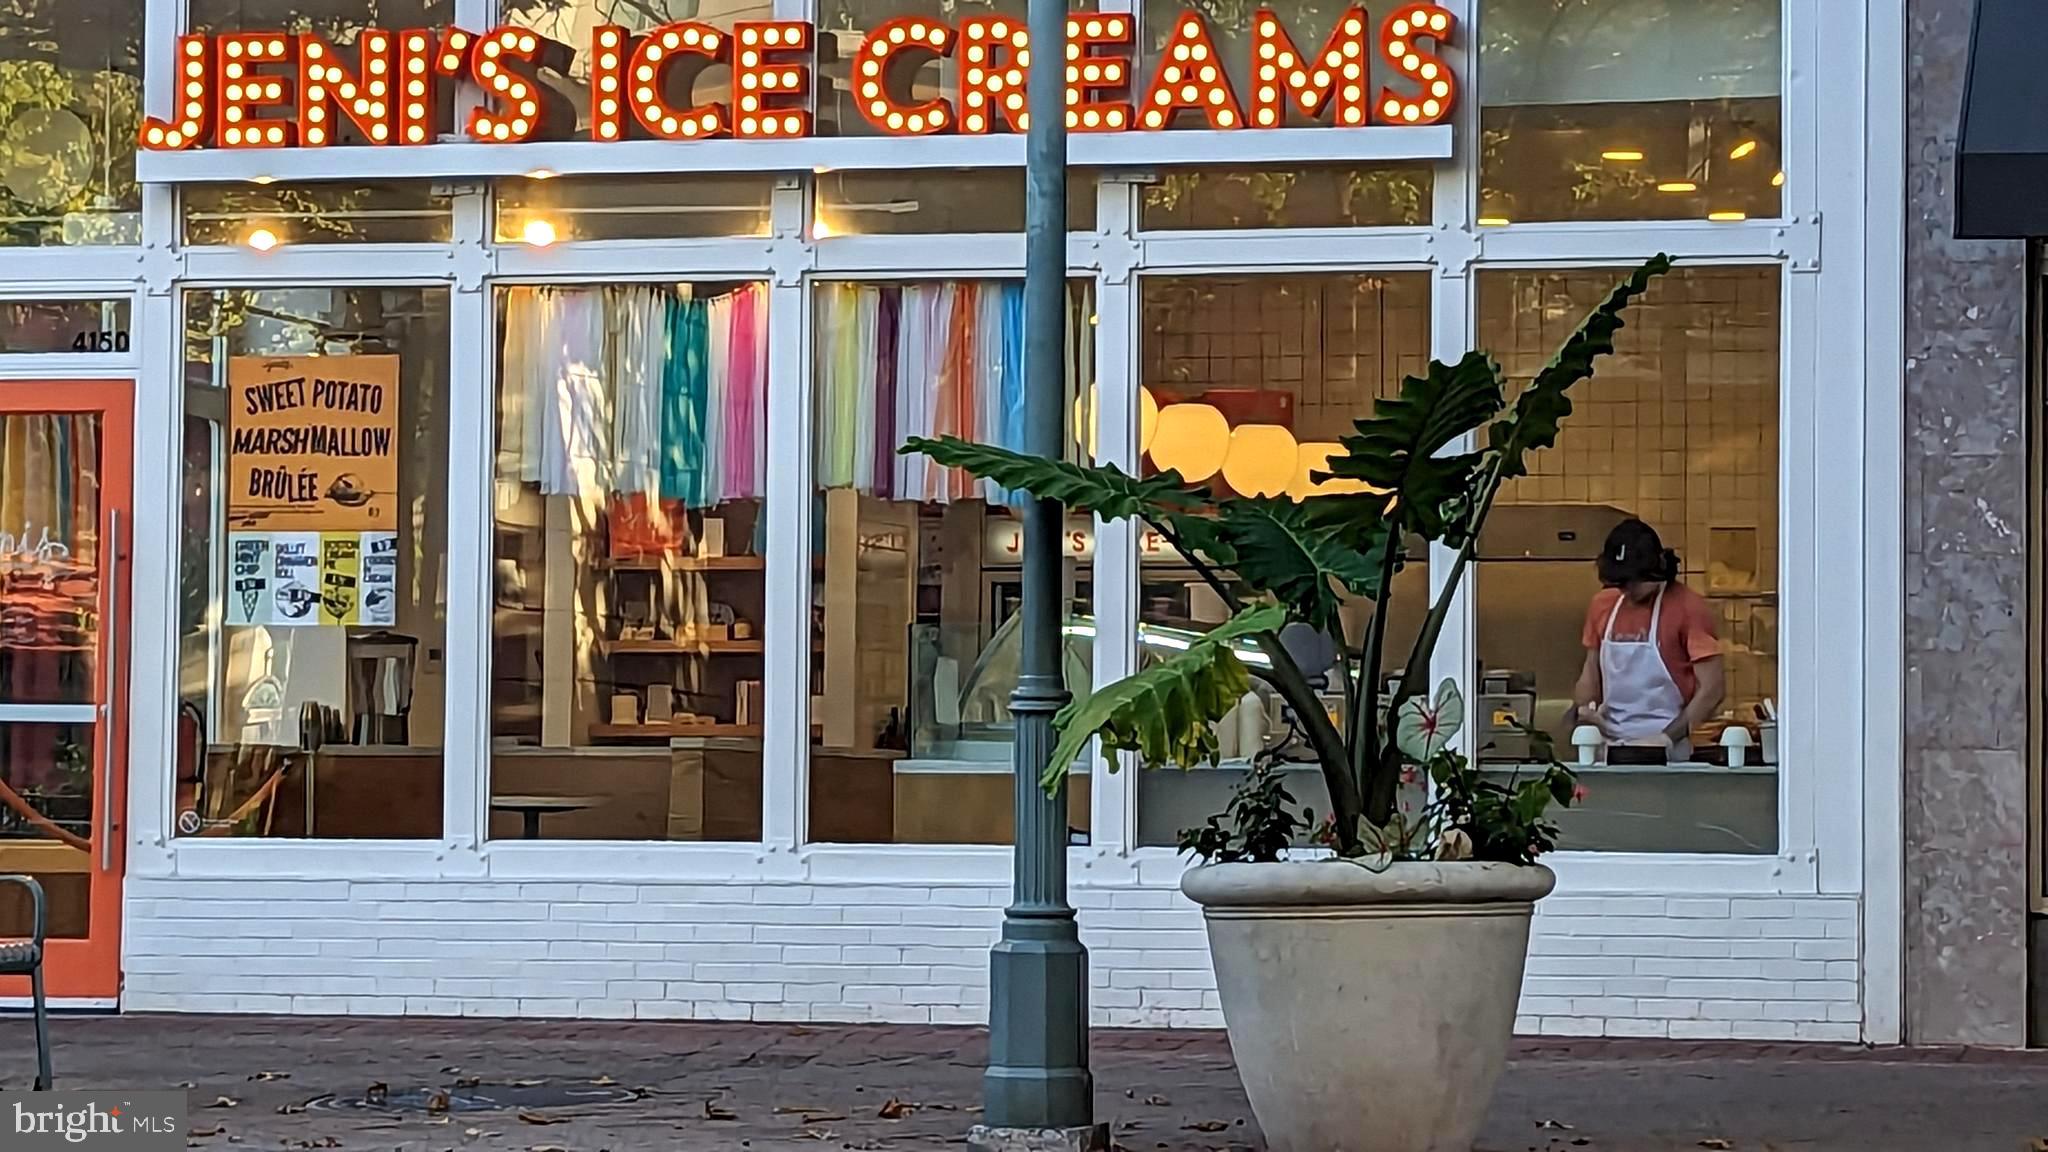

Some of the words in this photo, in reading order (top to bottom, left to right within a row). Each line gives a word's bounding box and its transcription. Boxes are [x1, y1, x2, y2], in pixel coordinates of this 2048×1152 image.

[140, 24, 543, 151] JENI'S
[592, 20, 813, 141] ICE
[852, 3, 1457, 135] CREAMS
[244, 376, 306, 415] SWEET
[312, 378, 383, 414] POTATO
[232, 425, 392, 457] MARSHMALLOW
[248, 465, 319, 503] BRÛLÉE
[1615, 544, 1626, 561] J
